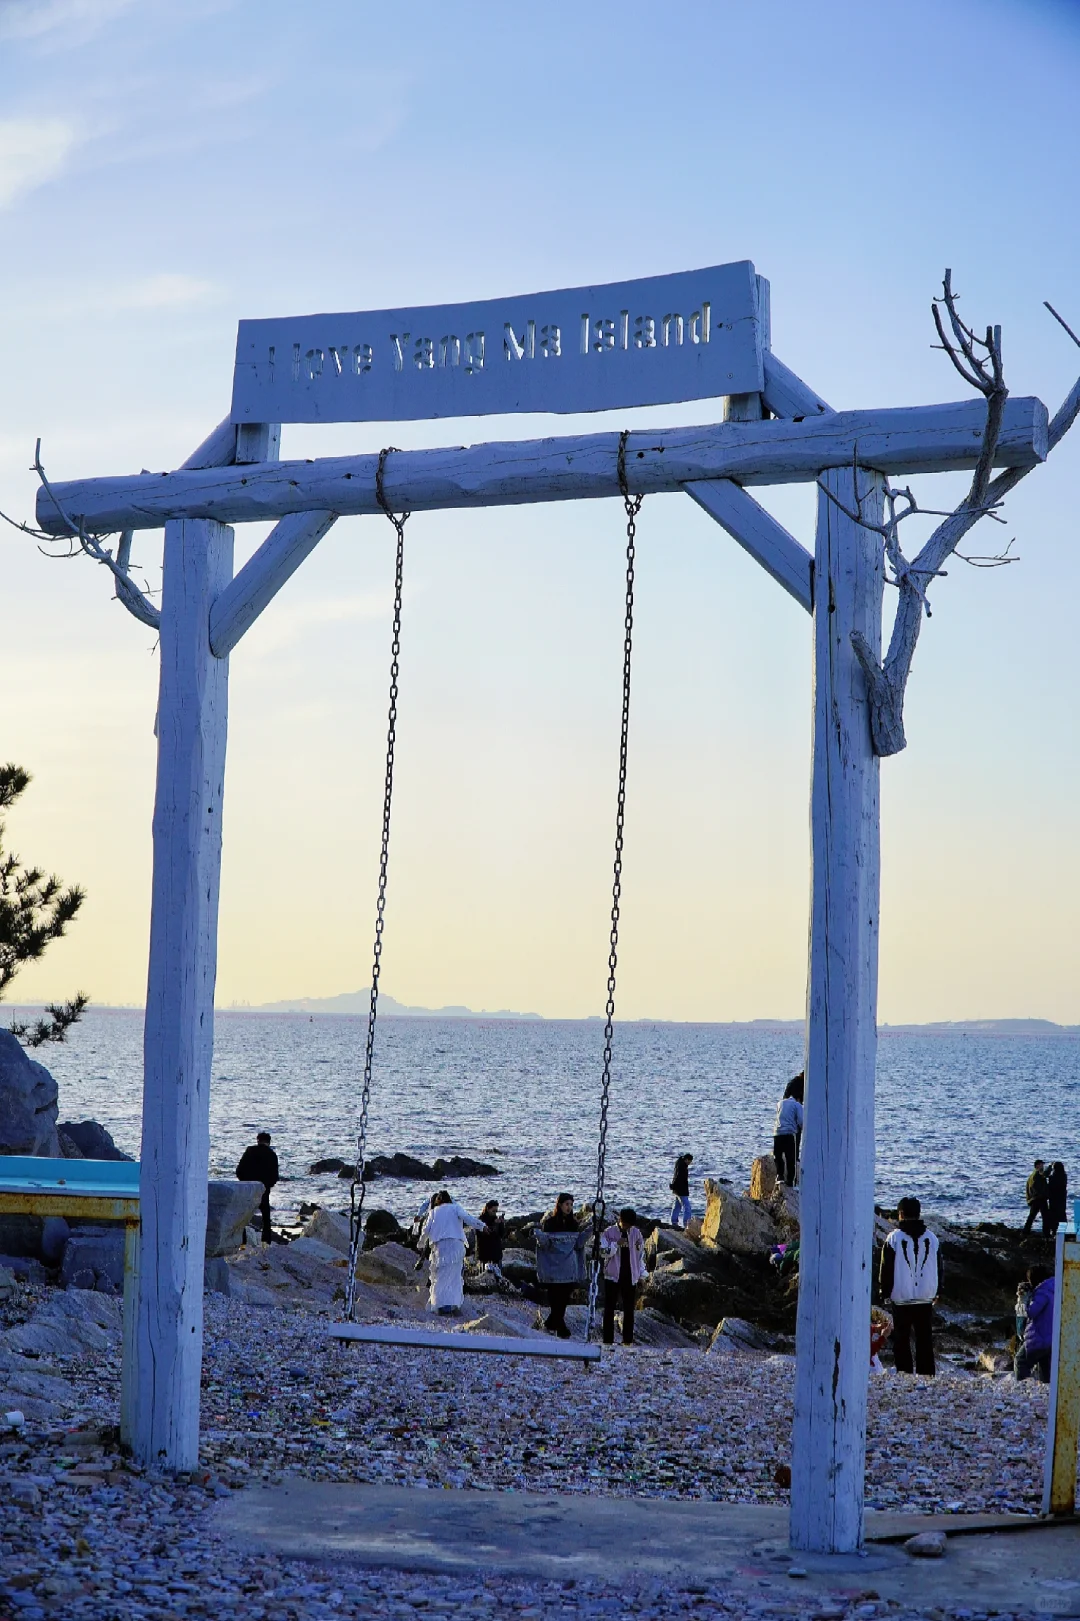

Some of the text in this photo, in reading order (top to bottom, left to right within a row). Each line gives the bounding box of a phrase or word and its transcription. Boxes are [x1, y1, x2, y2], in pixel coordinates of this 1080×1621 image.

[268, 346, 275, 383] I
[390, 332, 485, 375] Yang
[503, 319, 562, 360] Ma
[580, 301, 711, 354] Island
